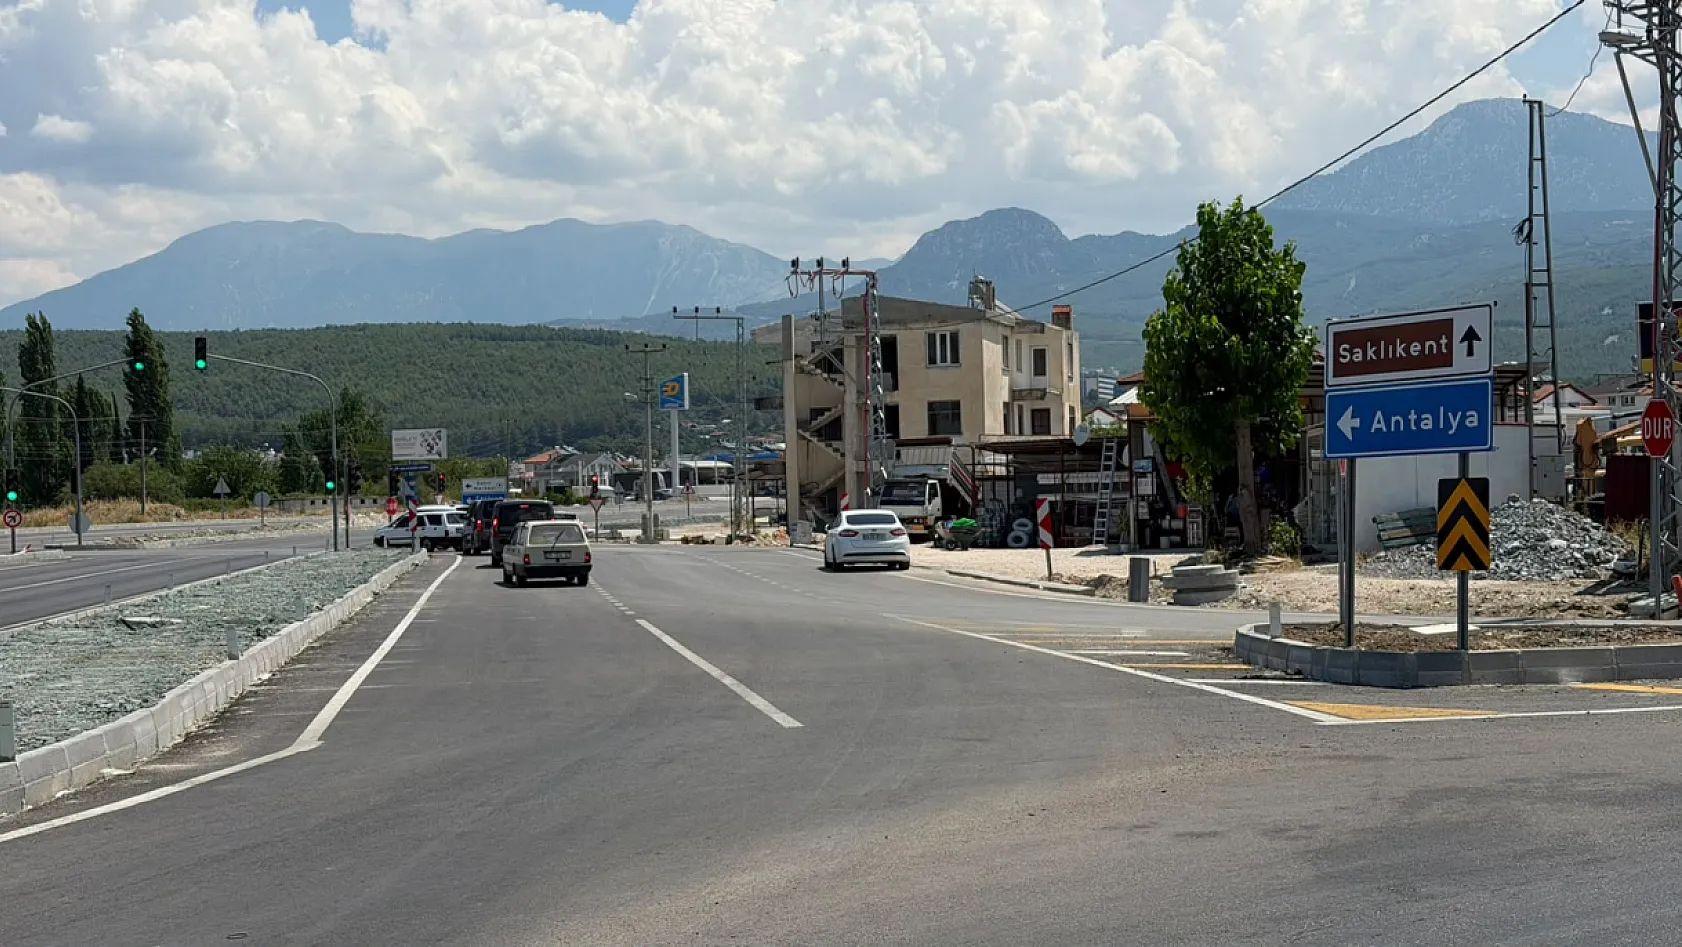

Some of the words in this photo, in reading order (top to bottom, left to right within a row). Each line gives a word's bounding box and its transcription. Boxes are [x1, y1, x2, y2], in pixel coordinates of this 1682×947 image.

[1338, 334, 1448, 364] Saklıkent
[1370, 405, 1479, 435] Antalya
[1644, 417, 1672, 440] DUR
